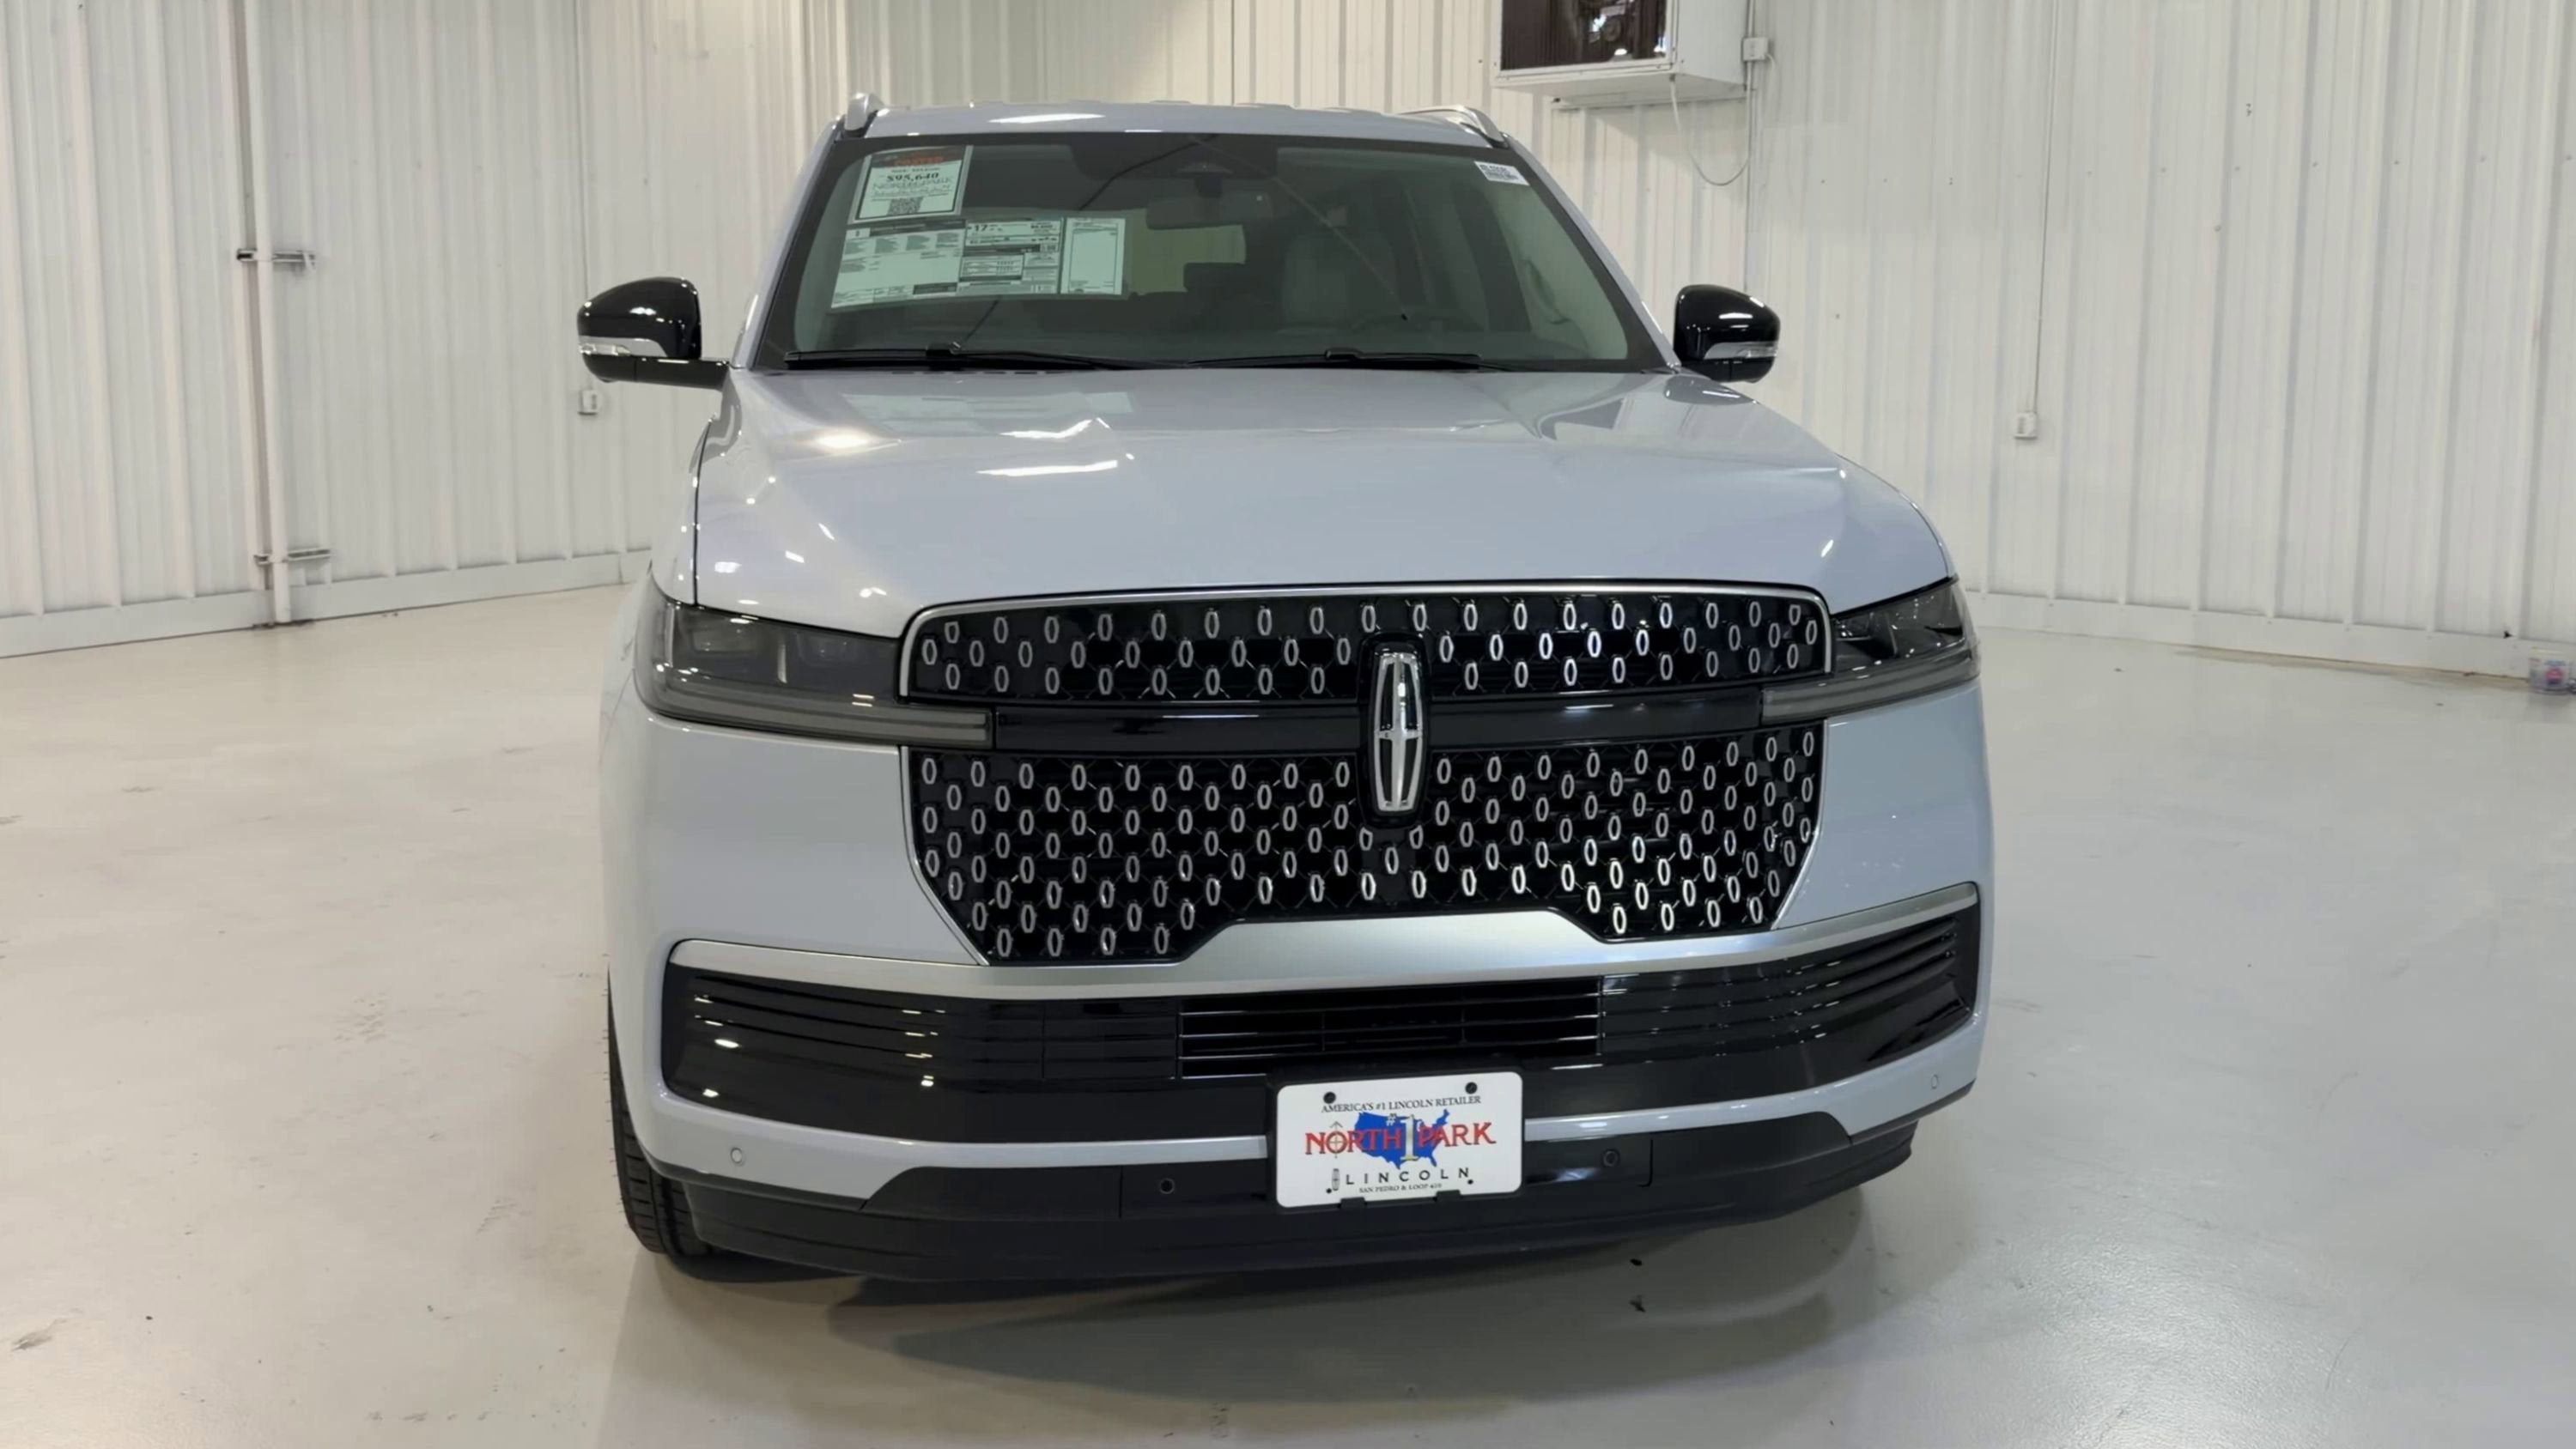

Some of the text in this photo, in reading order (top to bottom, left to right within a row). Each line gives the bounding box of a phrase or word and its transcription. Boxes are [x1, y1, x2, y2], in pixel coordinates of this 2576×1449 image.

[1321, 1095, 1481, 1113] AMERICA'S #1 LINCOLN RETAILER
[1305, 1122, 1497, 1155] NORTH PARK
[1346, 1167, 1469, 1185] LINCOLN
